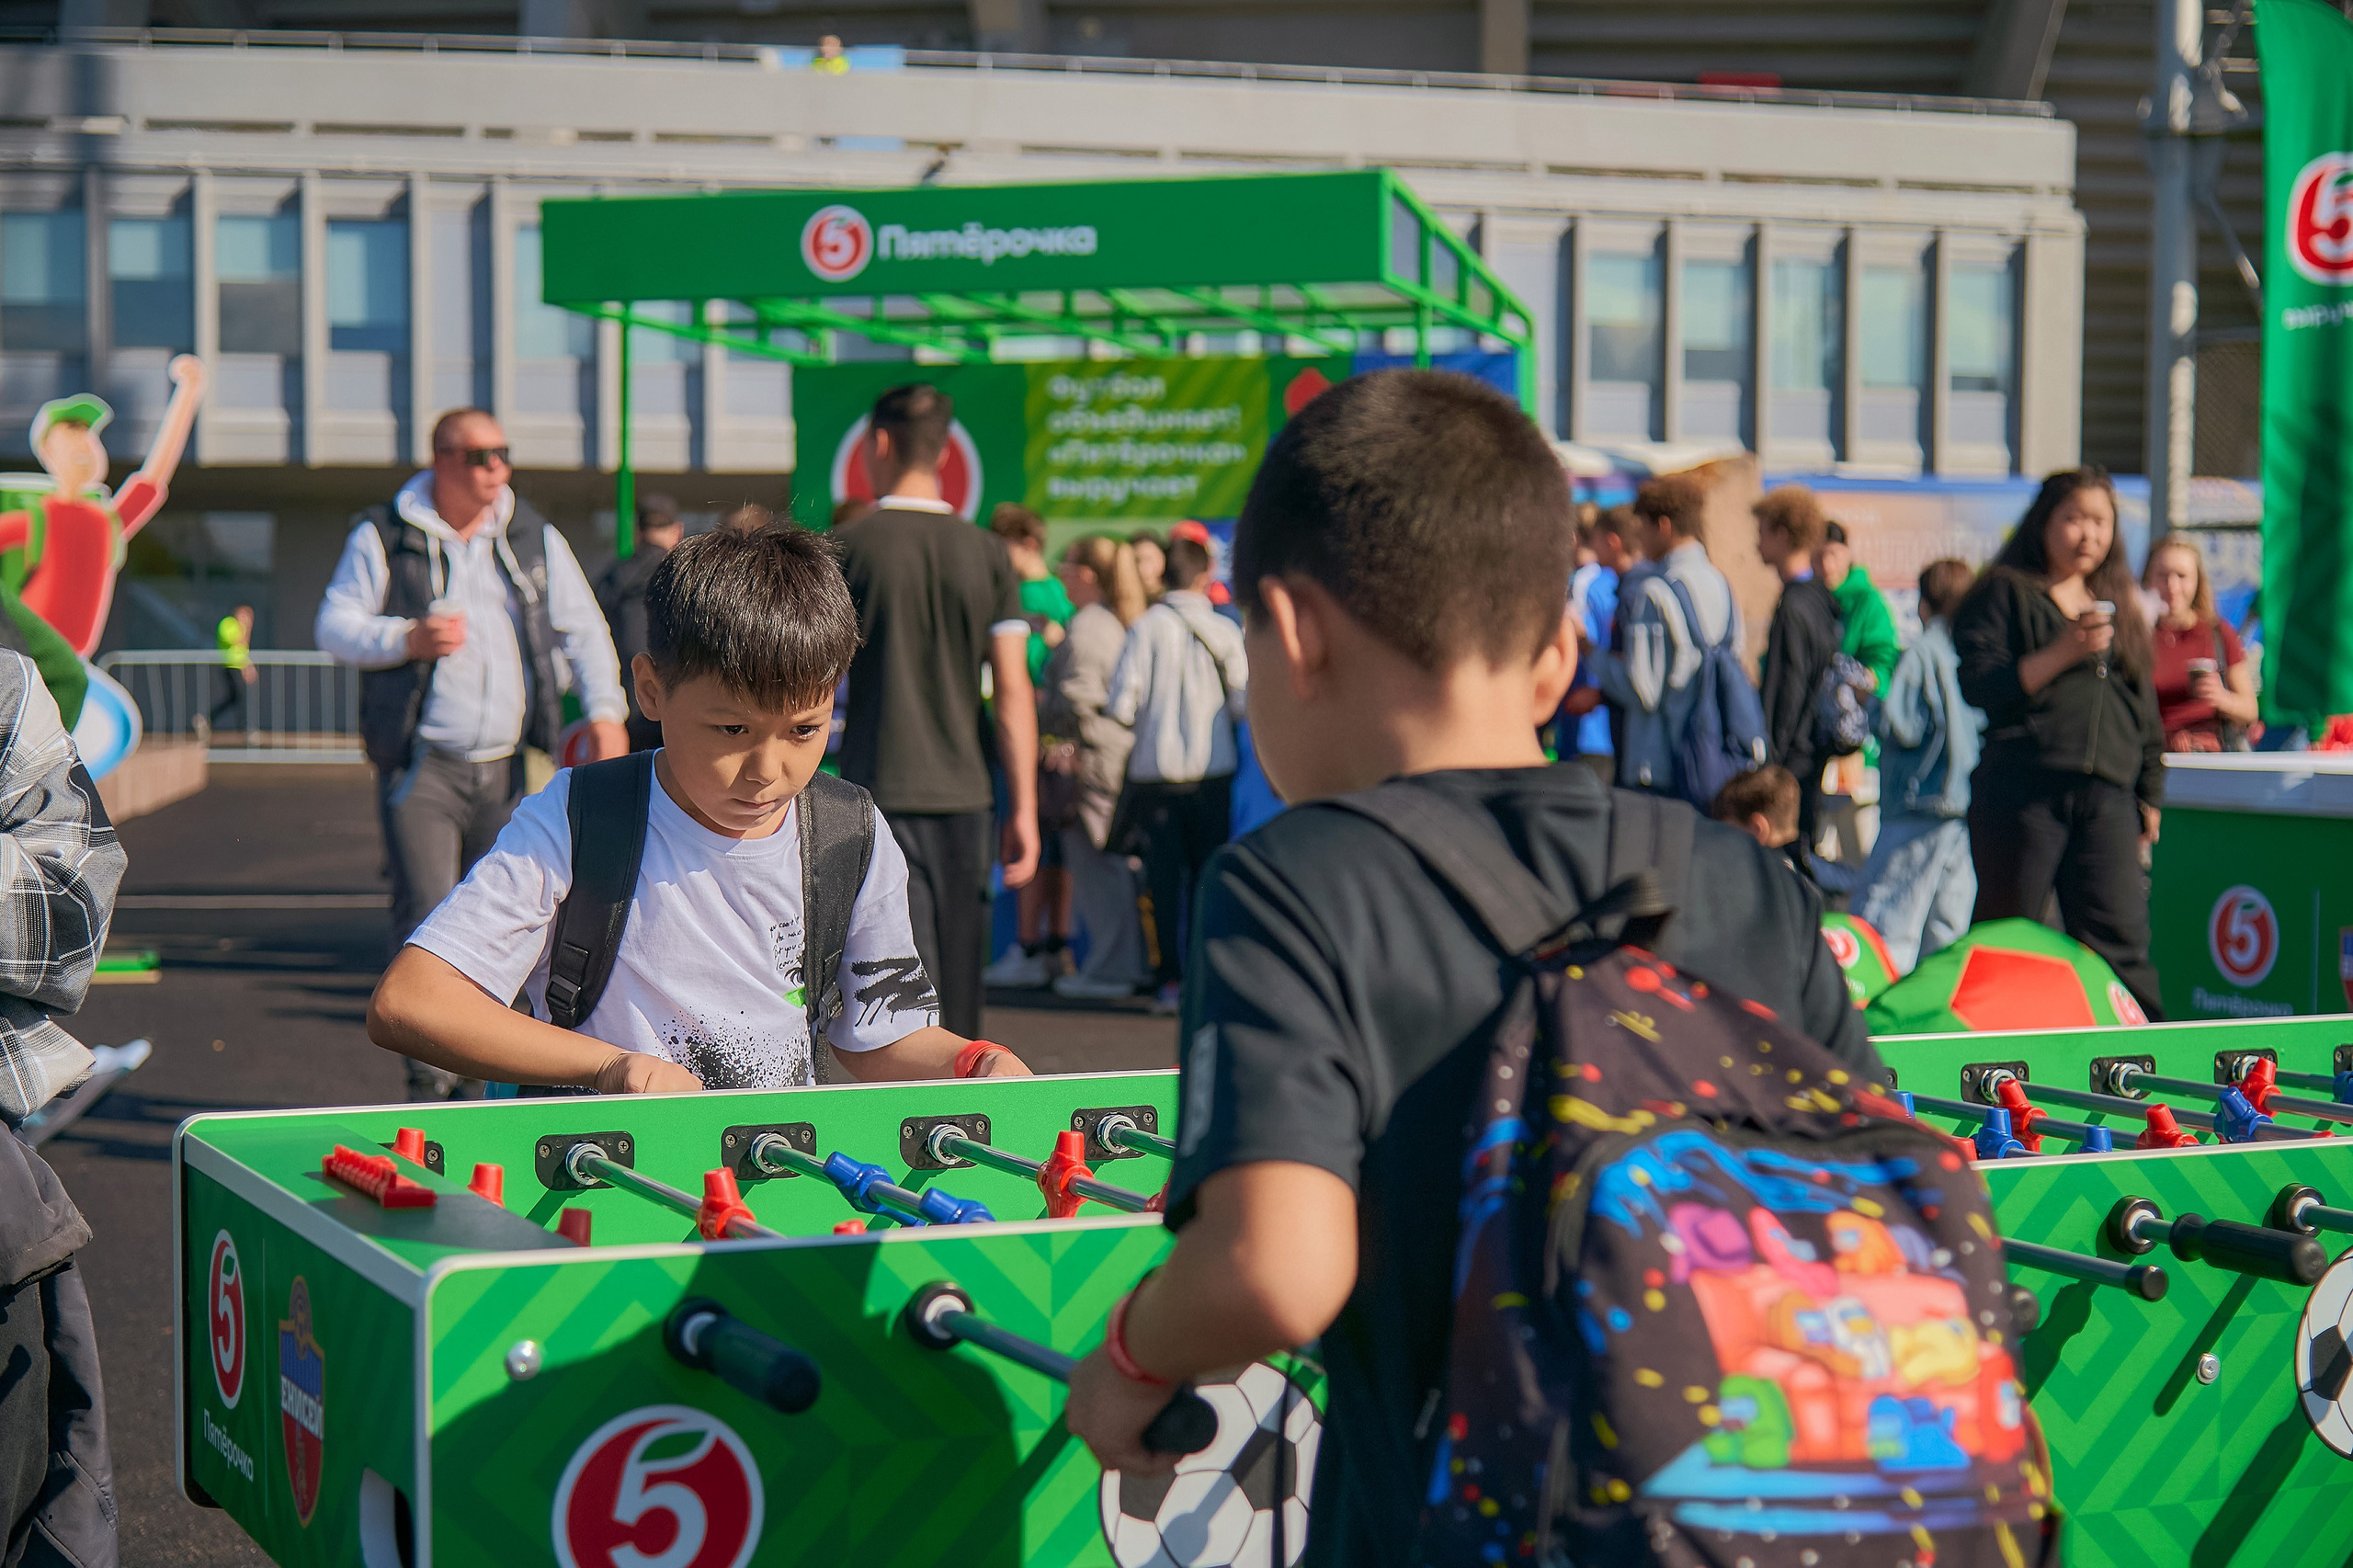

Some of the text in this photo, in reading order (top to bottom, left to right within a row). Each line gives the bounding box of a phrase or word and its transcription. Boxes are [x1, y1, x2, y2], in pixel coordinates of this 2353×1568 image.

[878, 222, 1097, 267] Пятёрочка
[281, 1375, 324, 1441] ЕНИСЕЙ
[203, 1408, 254, 1483] Пятёрочка
[608, 1421, 726, 1568] 5
